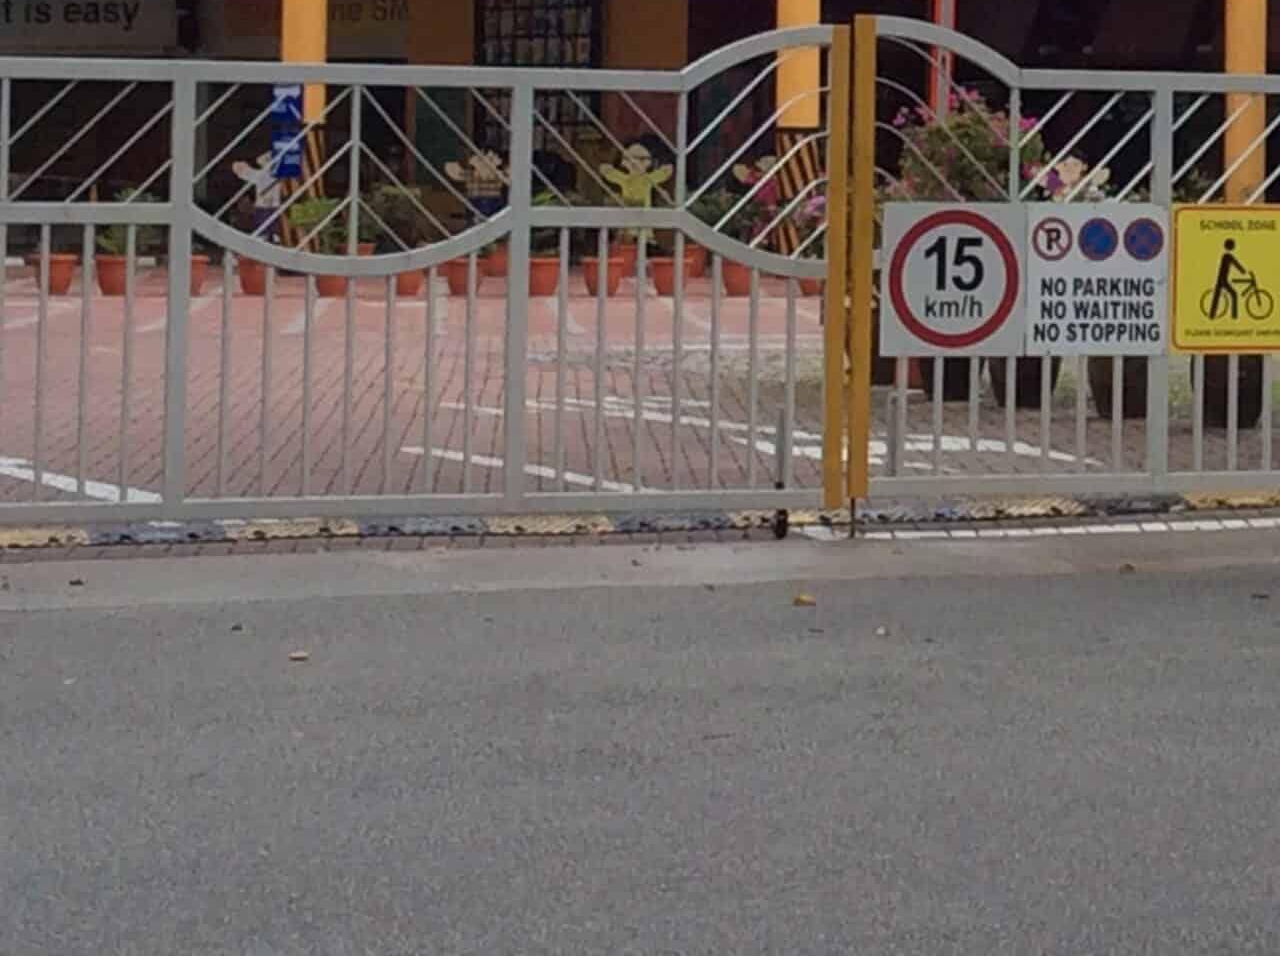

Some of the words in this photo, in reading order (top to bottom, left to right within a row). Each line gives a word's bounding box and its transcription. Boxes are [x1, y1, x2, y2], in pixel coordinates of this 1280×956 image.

[63, 2, 139, 31] easy
[924, 235, 985, 292] 15
[1041, 278, 1067, 296] NO
[1073, 278, 1155, 296] PARKING
[924, 294, 983, 318] km/h
[1041, 301, 1067, 319] NO
[1073, 301, 1154, 319] WAITING
[1034, 323, 1060, 342] NO
[1065, 323, 1161, 342] STOPPING
